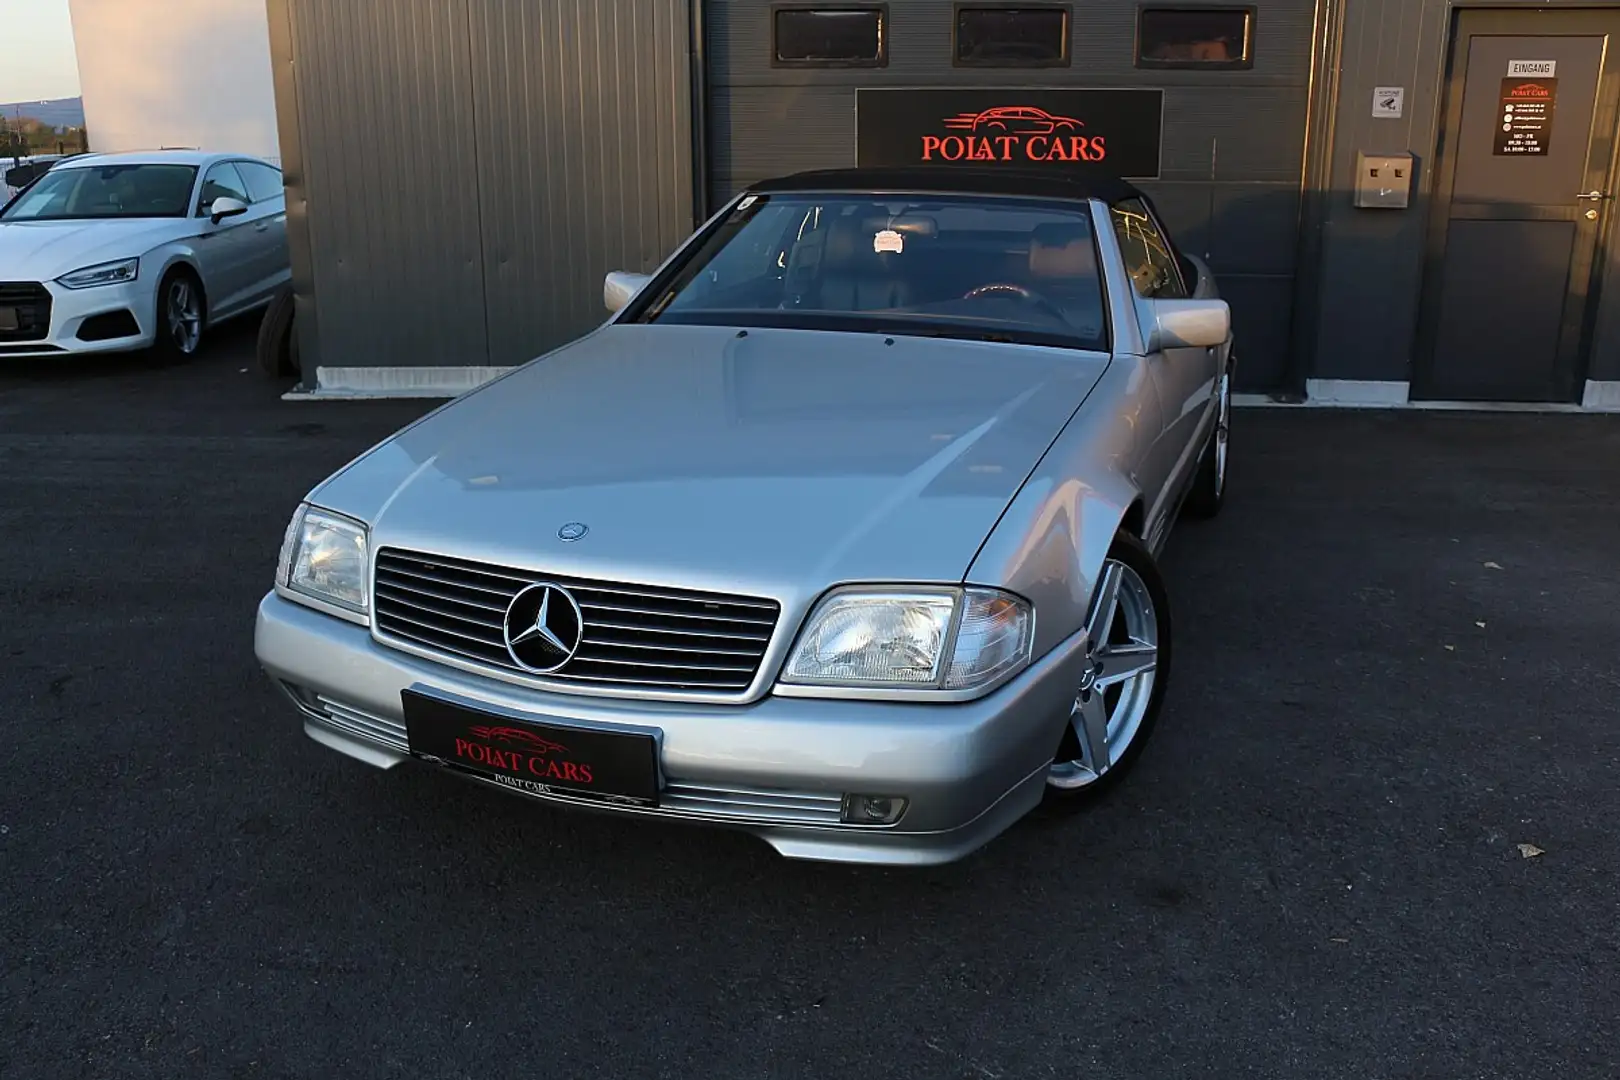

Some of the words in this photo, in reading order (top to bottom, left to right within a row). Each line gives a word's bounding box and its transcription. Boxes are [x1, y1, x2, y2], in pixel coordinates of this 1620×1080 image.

[1513, 63, 1550, 73] EINGANG
[1026, 136, 1106, 161] CARS
[528, 757, 594, 783] CARS
[525, 780, 551, 793] CARS
